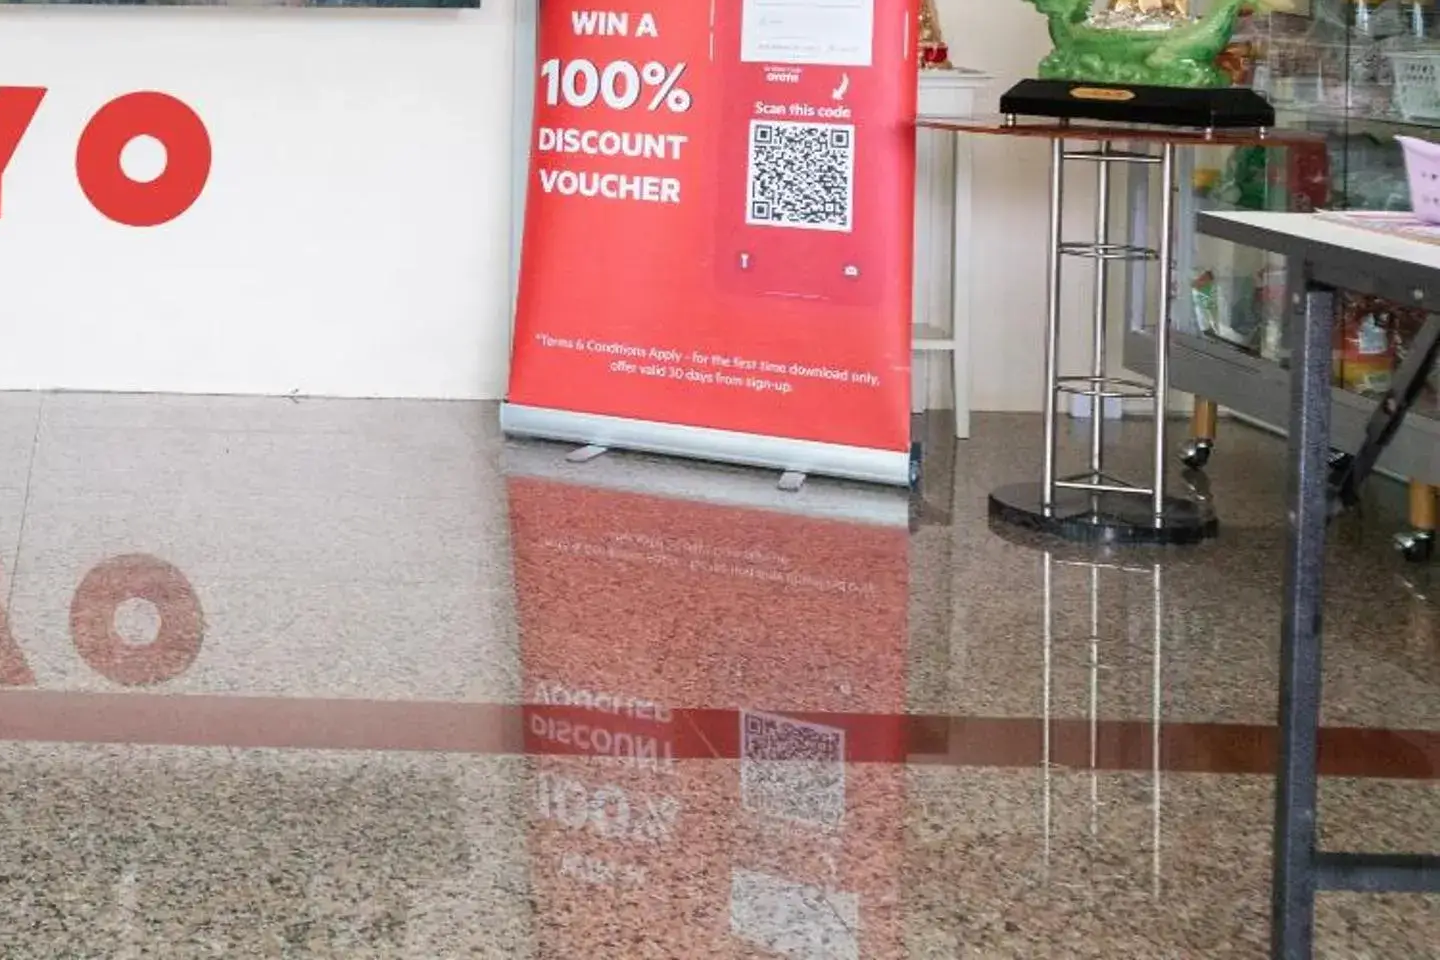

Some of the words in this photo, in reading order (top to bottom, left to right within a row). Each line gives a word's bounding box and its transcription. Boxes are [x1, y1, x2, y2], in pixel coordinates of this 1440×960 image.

[571, 10, 629, 37] WIN
[637, 13, 658, 37] A
[541, 58, 692, 113] 100%
[755, 100, 786, 115] Scan
[790, 102, 815, 116] this
[818, 105, 851, 118] code
[539, 127, 688, 160] DISCOUNT
[539, 169, 681, 203] VOUCHER
[586, 339, 647, 358] Conditions
[650, 346, 682, 363] Apply
[692, 350, 709, 364] for
[711, 353, 730, 368] the
[733, 355, 757, 371] first
[789, 361, 848, 382] download
[610, 361, 637, 376] offer
[639, 363, 666, 378] valid
[668, 366, 685, 380] 30
[685, 367, 713, 385] days
[716, 371, 743, 387] from
